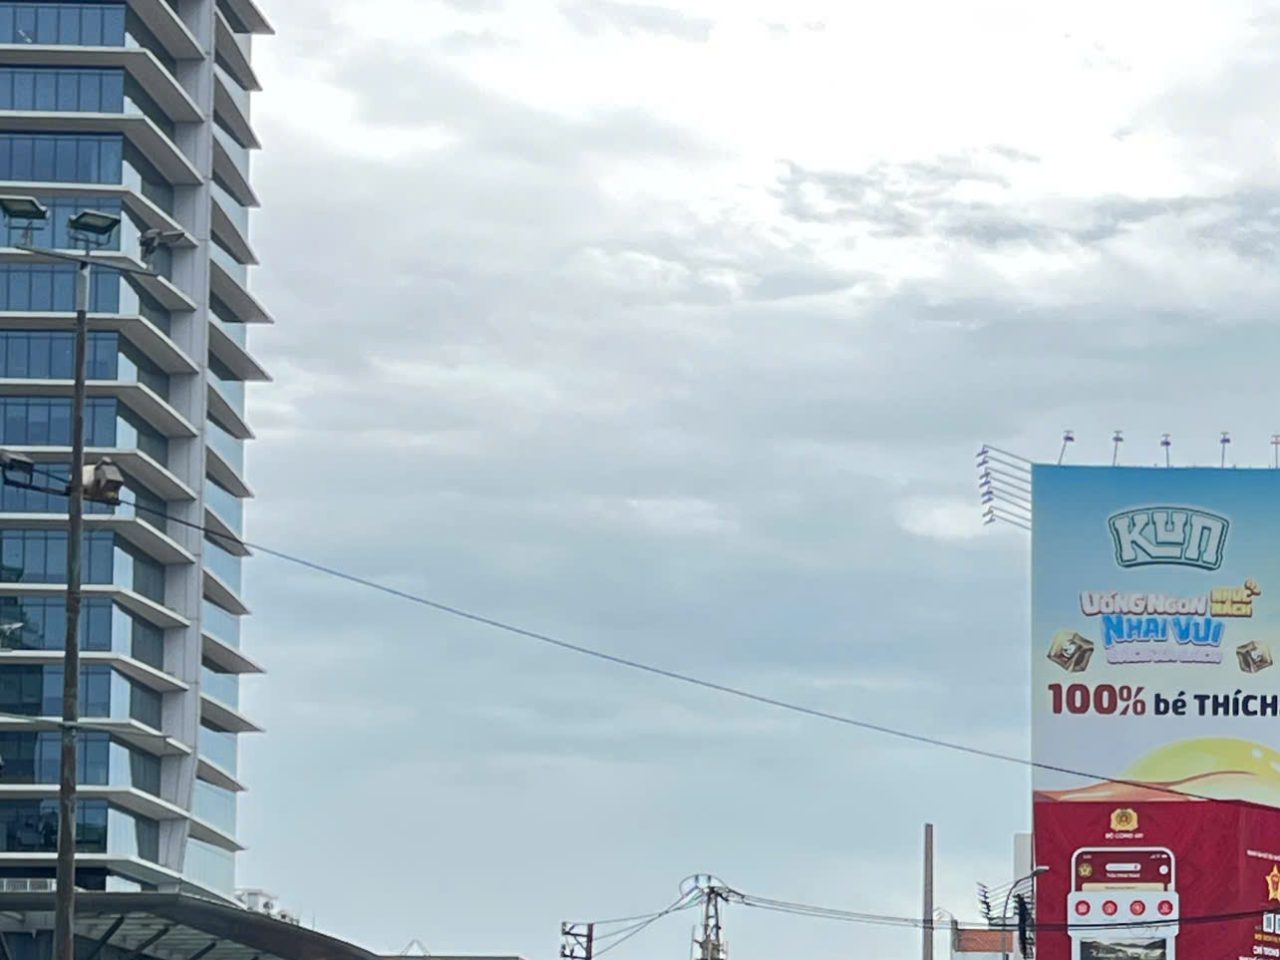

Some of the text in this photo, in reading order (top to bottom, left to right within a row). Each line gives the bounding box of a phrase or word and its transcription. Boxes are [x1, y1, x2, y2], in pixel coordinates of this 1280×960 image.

[1103, 615, 1224, 648] NHAI VUI
[1048, 683, 1279, 717] 100% bé THÍCH
